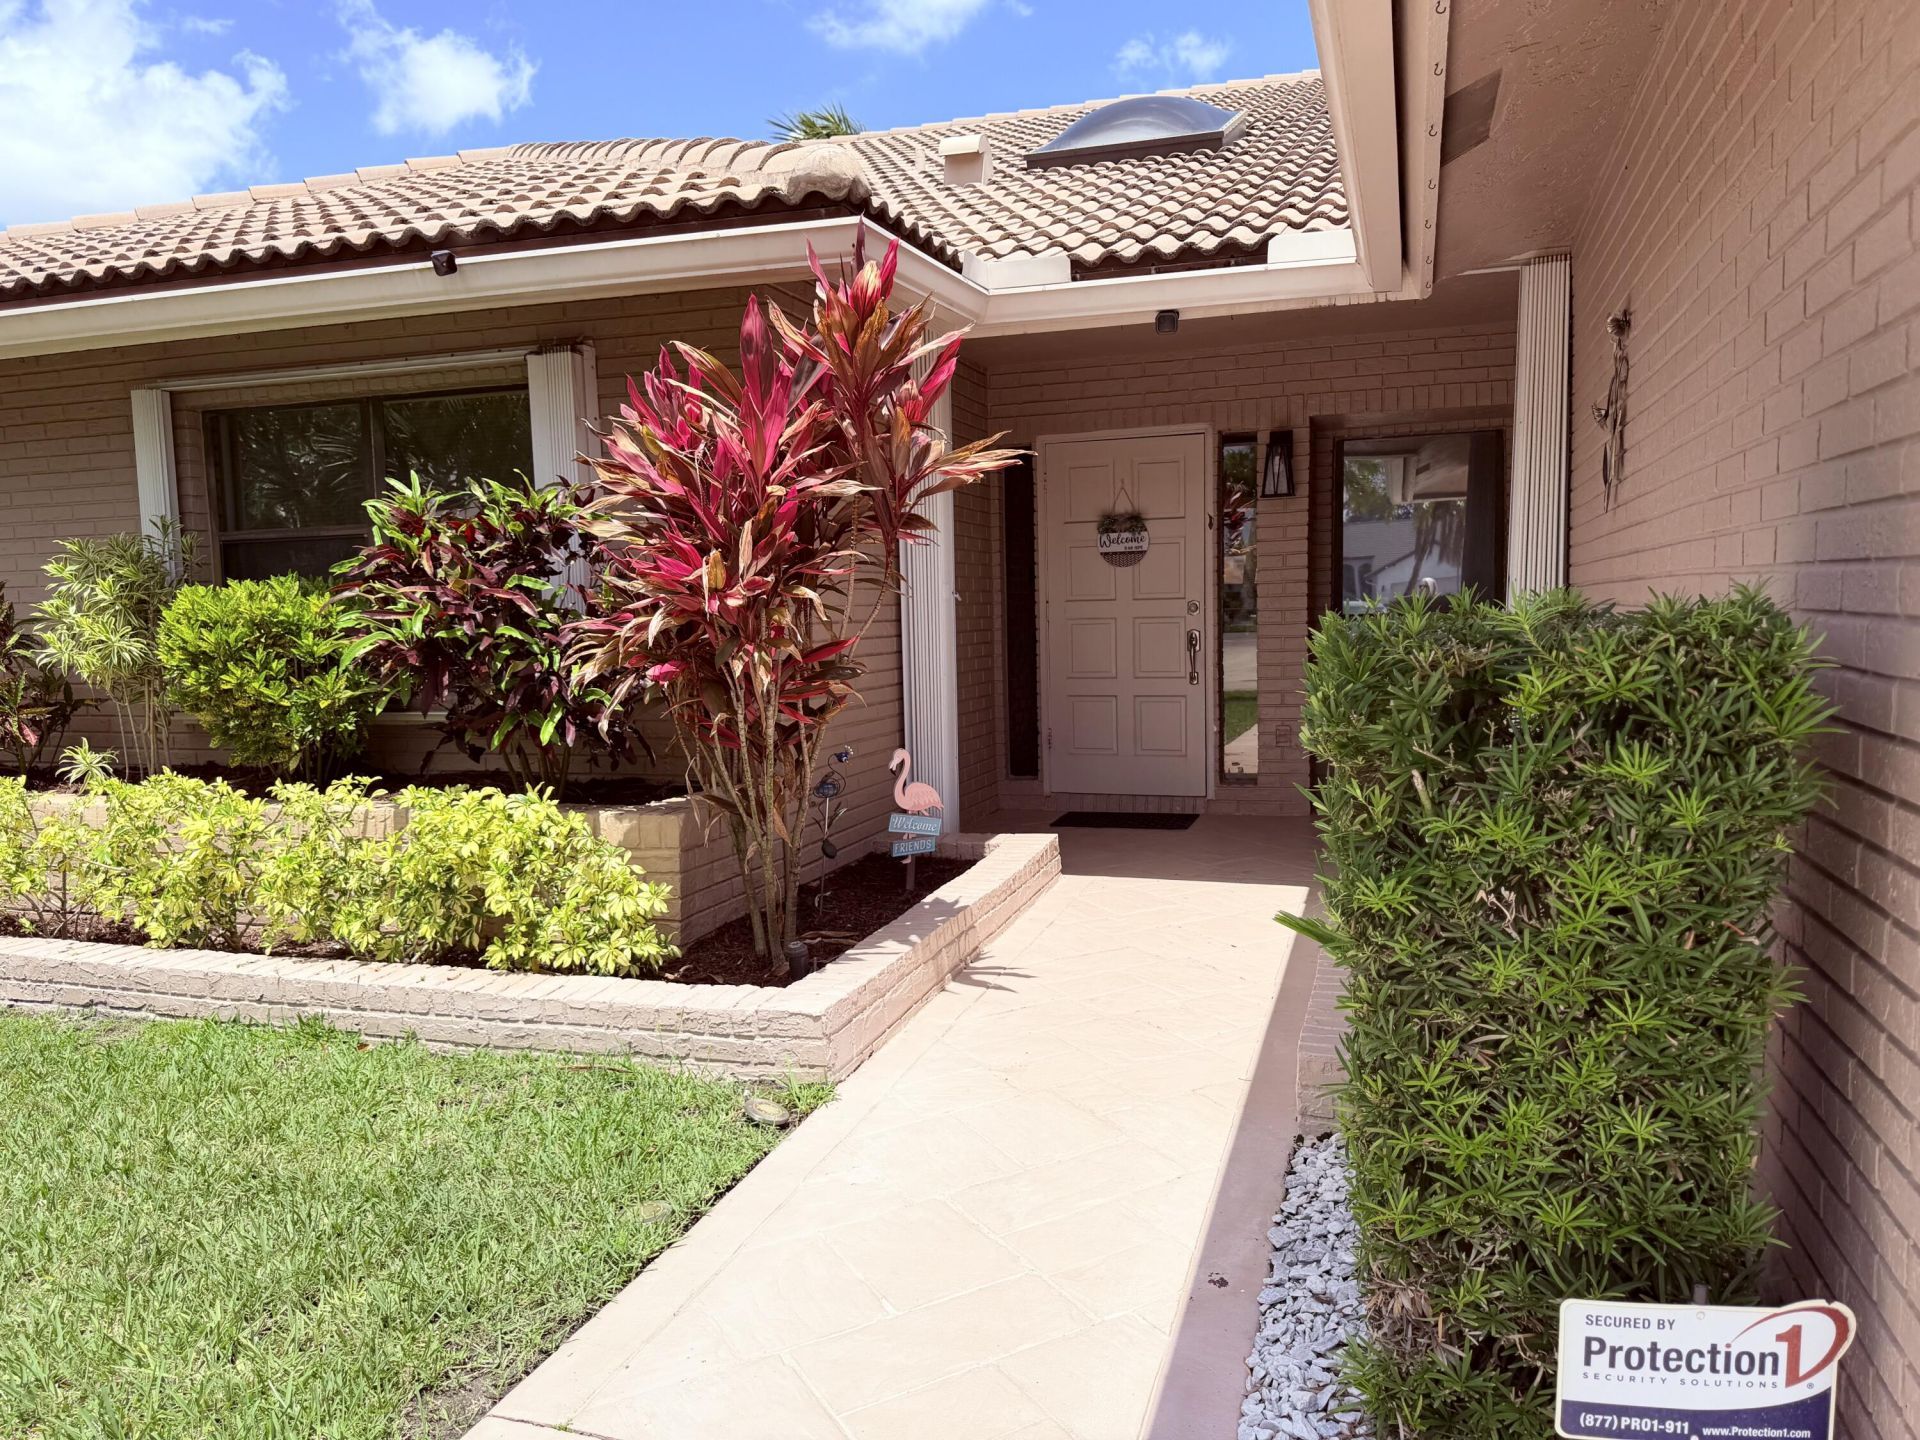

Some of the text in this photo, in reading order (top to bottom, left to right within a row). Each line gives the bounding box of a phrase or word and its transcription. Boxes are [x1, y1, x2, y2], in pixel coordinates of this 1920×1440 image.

[1100, 533, 1145, 548] Welcome
[892, 816, 937, 831] Welcome
[894, 839, 932, 853] FRIENDS
[1585, 1314, 1676, 1331] SECURED BY
[1583, 1335, 1779, 1377] Protection
[1582, 1371, 1778, 1389] SECURITY SOLUTIONS
[1579, 1412, 1618, 1431] (877)
[1702, 1425, 1812, 1439] www.Protection1.com
